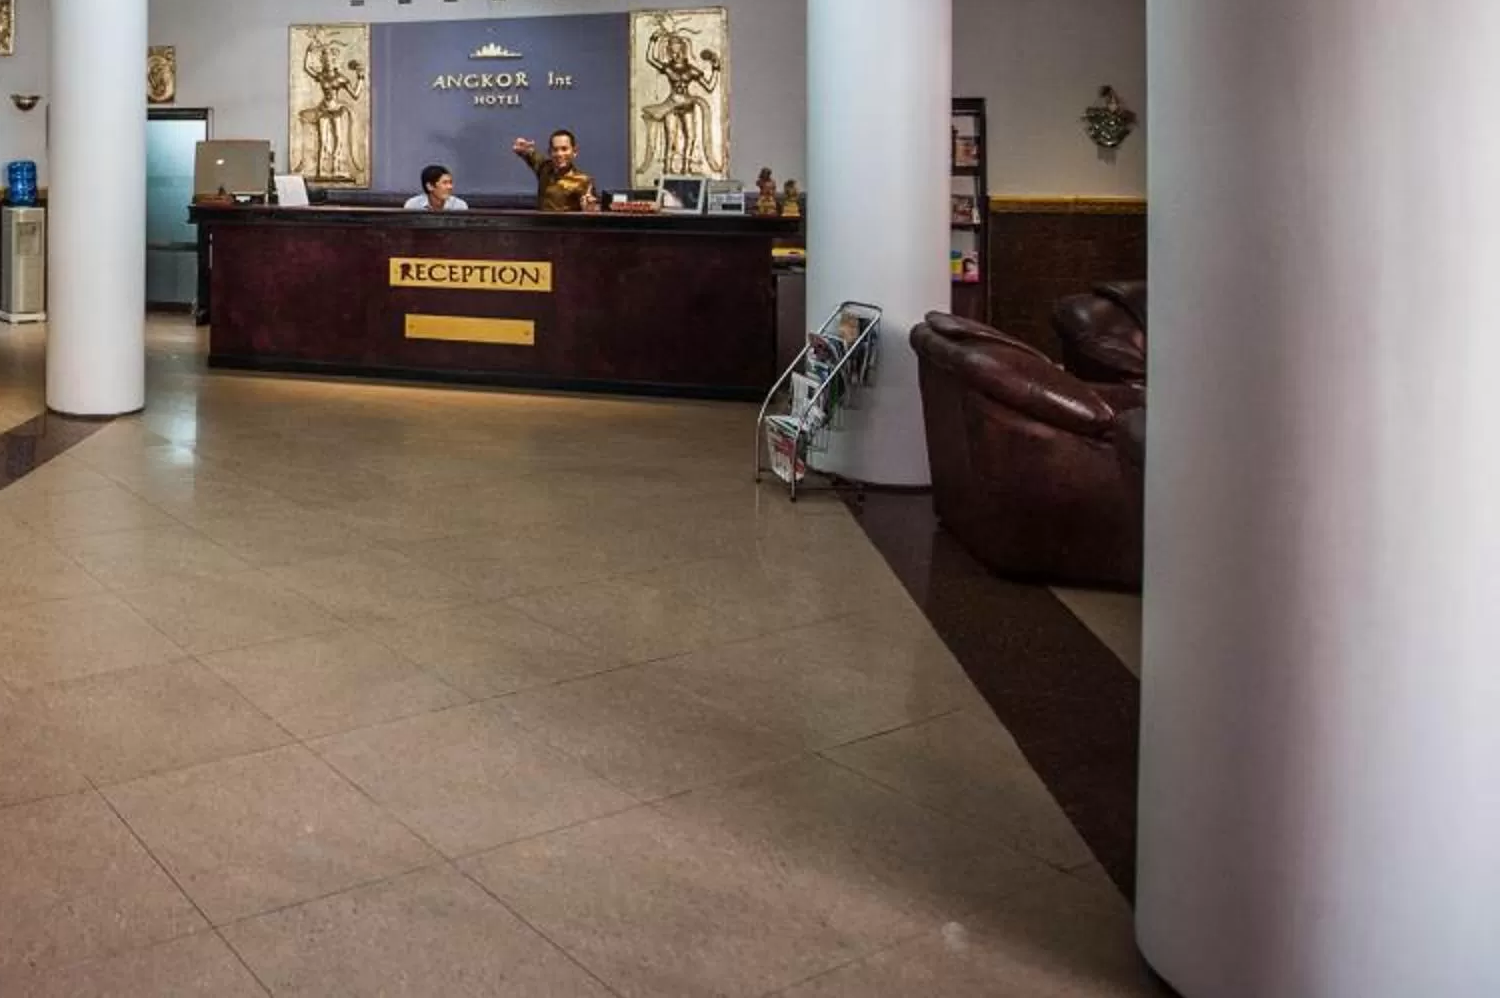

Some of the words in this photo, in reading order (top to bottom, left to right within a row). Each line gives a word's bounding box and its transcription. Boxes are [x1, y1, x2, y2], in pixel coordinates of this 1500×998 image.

[432, 71, 529, 89] ANGKOR
[473, 93, 521, 105] HOTEL
[399, 262, 540, 287] RECEPTION
